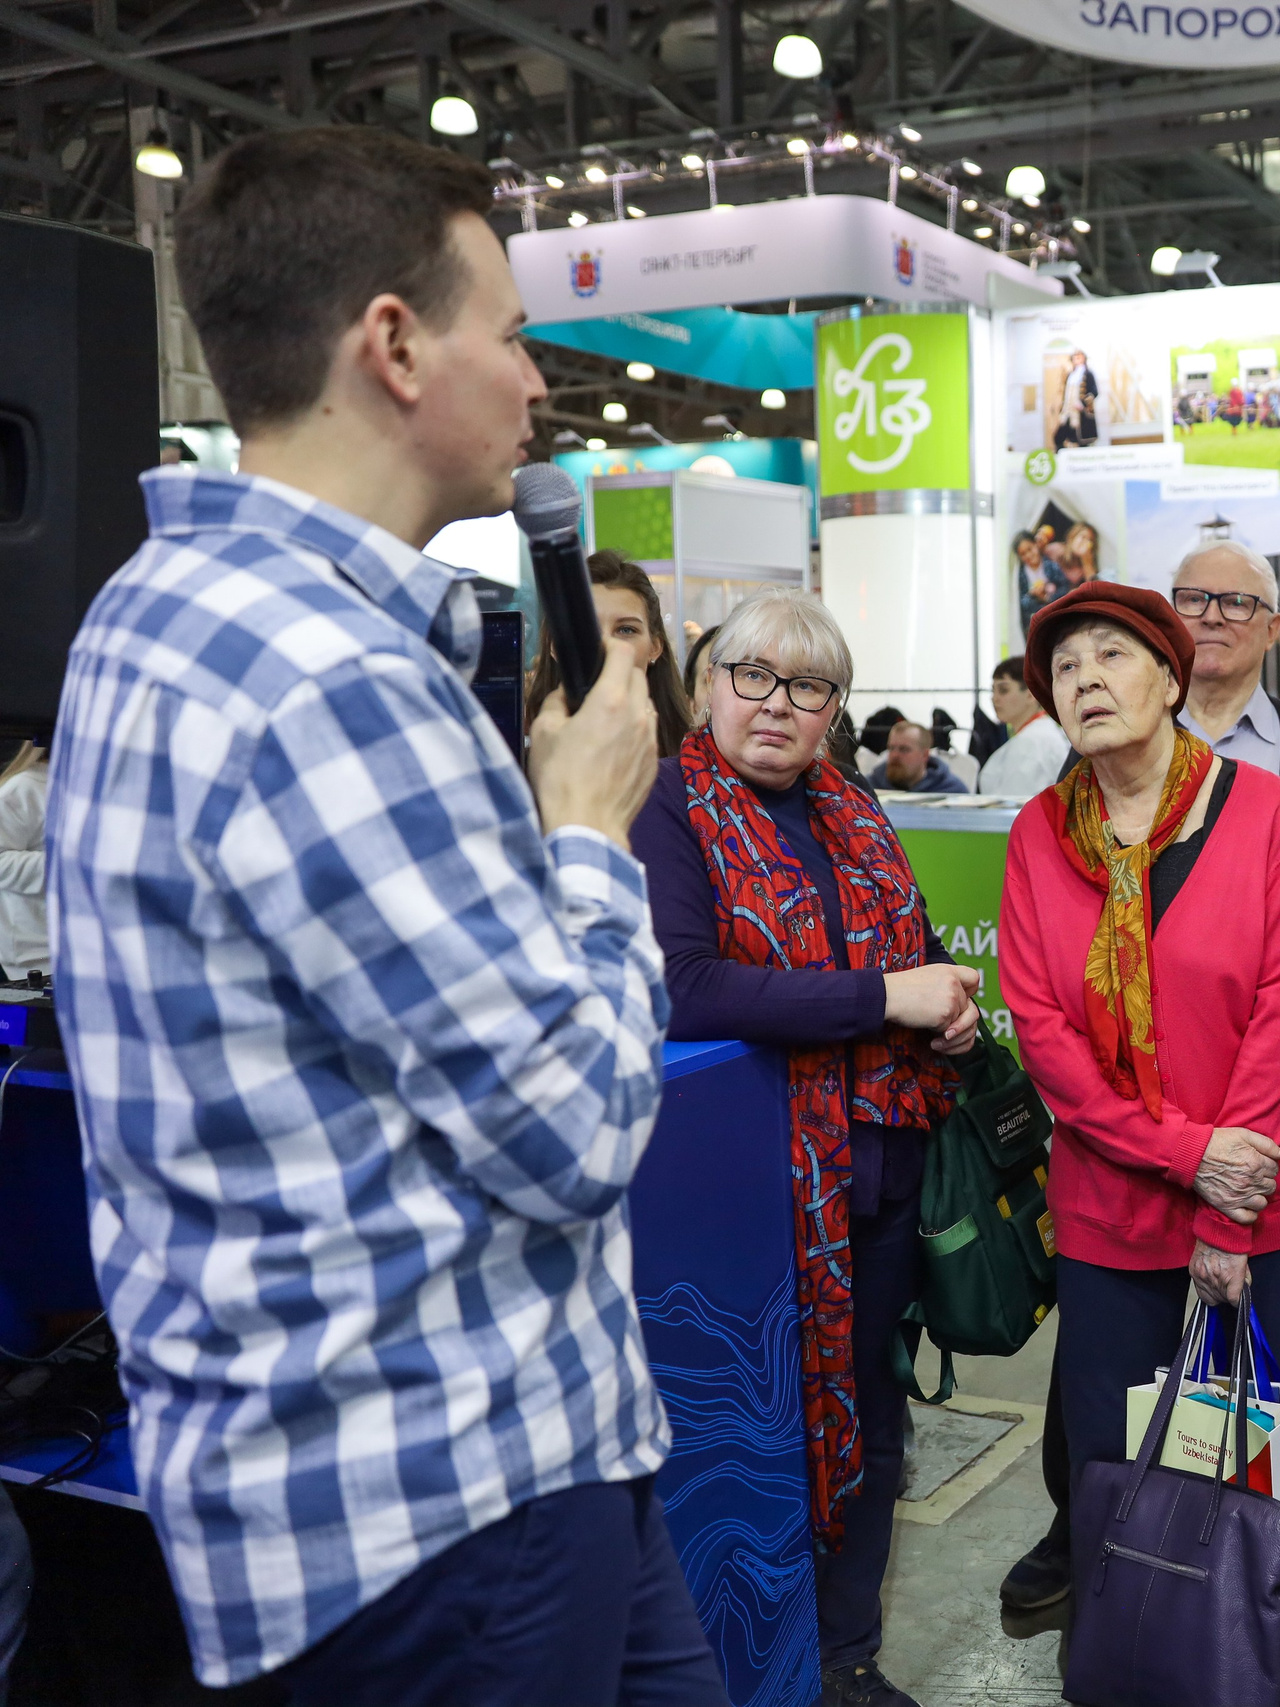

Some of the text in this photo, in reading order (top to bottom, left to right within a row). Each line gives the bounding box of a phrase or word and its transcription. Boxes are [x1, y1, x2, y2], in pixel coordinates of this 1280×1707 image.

[997, 1109, 1031, 1136] BEAUTIFUL
[1177, 1430, 1197, 1446] Tours
[1199, 1439, 1207, 1449] to
[1182, 1444, 1220, 1466] Uzbekista
